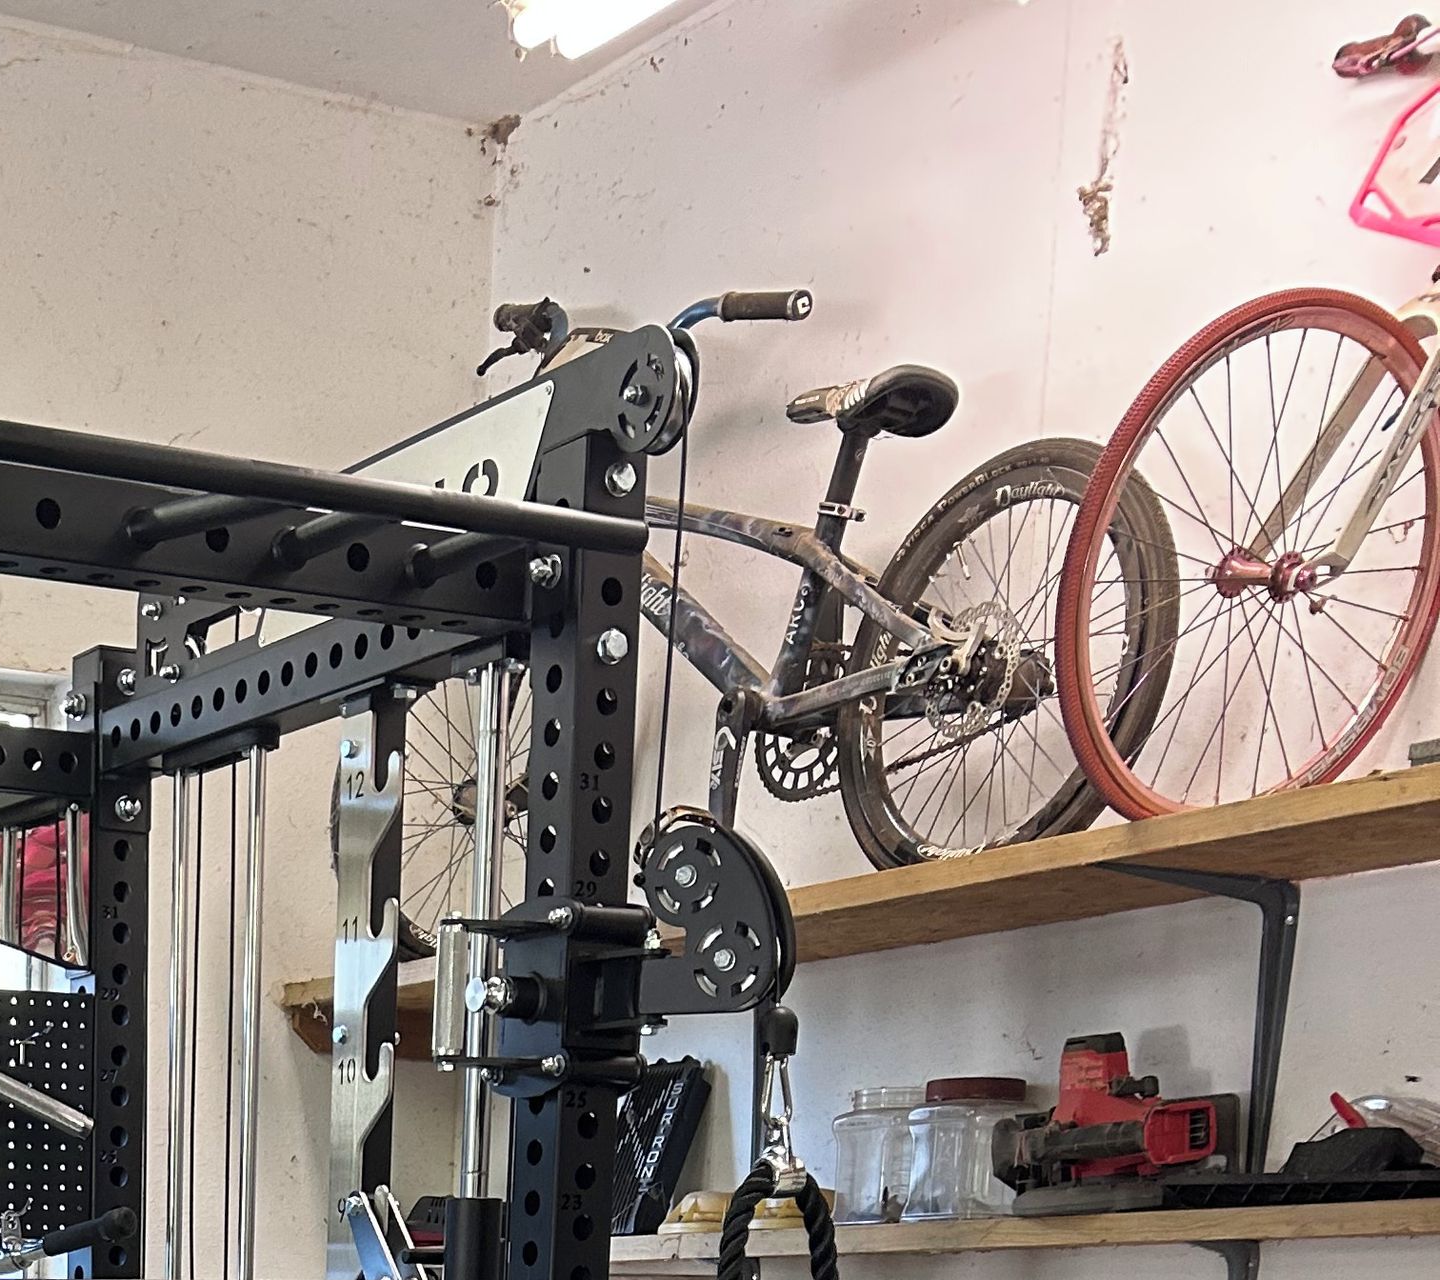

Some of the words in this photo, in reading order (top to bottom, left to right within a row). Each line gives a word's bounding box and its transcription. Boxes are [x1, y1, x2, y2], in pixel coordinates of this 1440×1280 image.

[346, 771, 366, 800] 12
[579, 772, 599, 791] 31
[574, 880, 597, 898] 29
[342, 916, 359, 944] 11
[338, 1058, 356, 1085] 10
[566, 1091, 587, 1108] 25
[561, 1193, 582, 1210] 23
